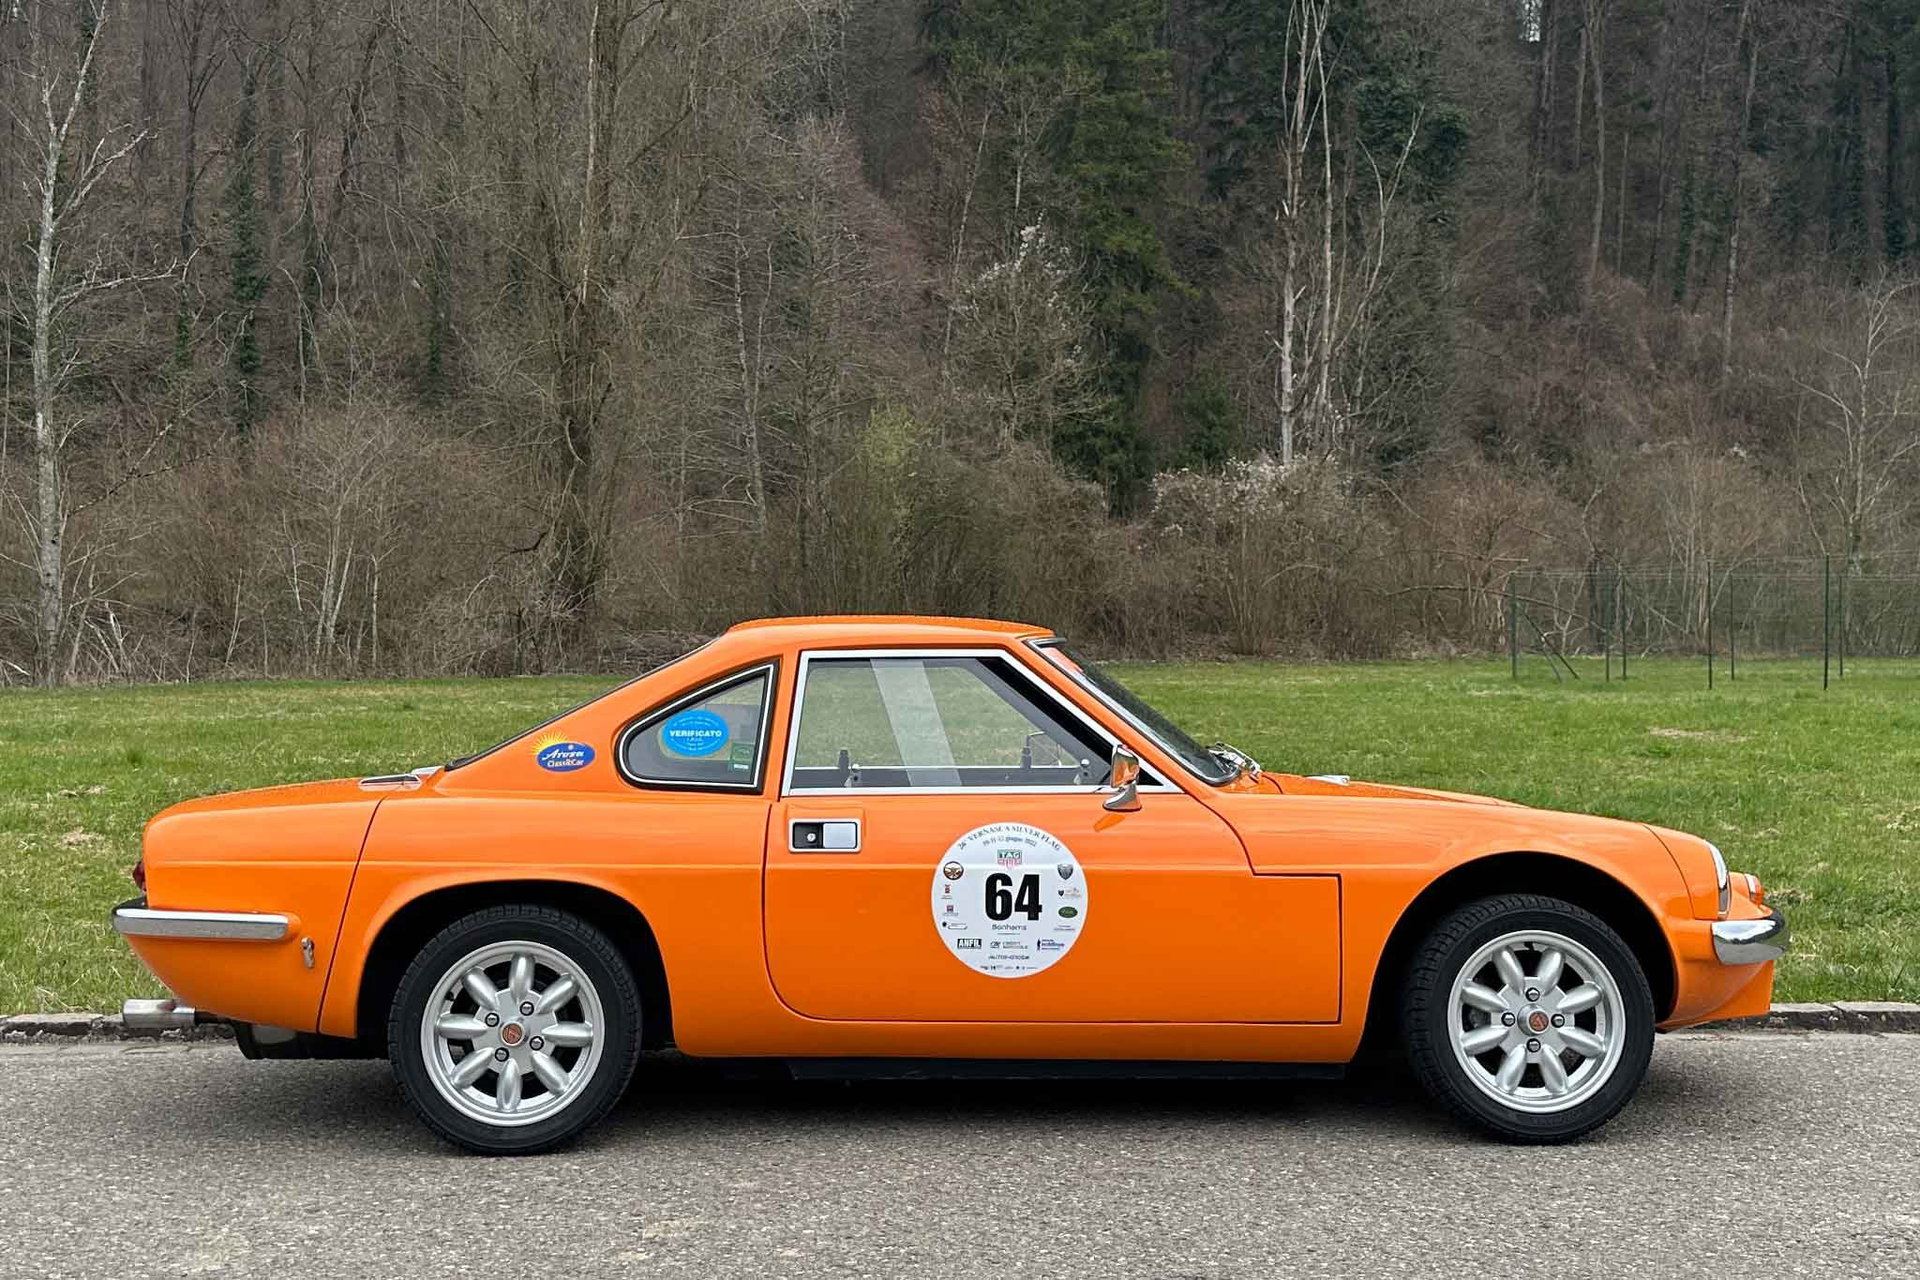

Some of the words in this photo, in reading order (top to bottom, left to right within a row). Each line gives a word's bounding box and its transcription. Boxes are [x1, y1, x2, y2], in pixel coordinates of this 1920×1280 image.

[1012, 826, 1041, 838] SILVER
[1041, 833, 1062, 851] FLAG
[985, 872, 1042, 921] 64
